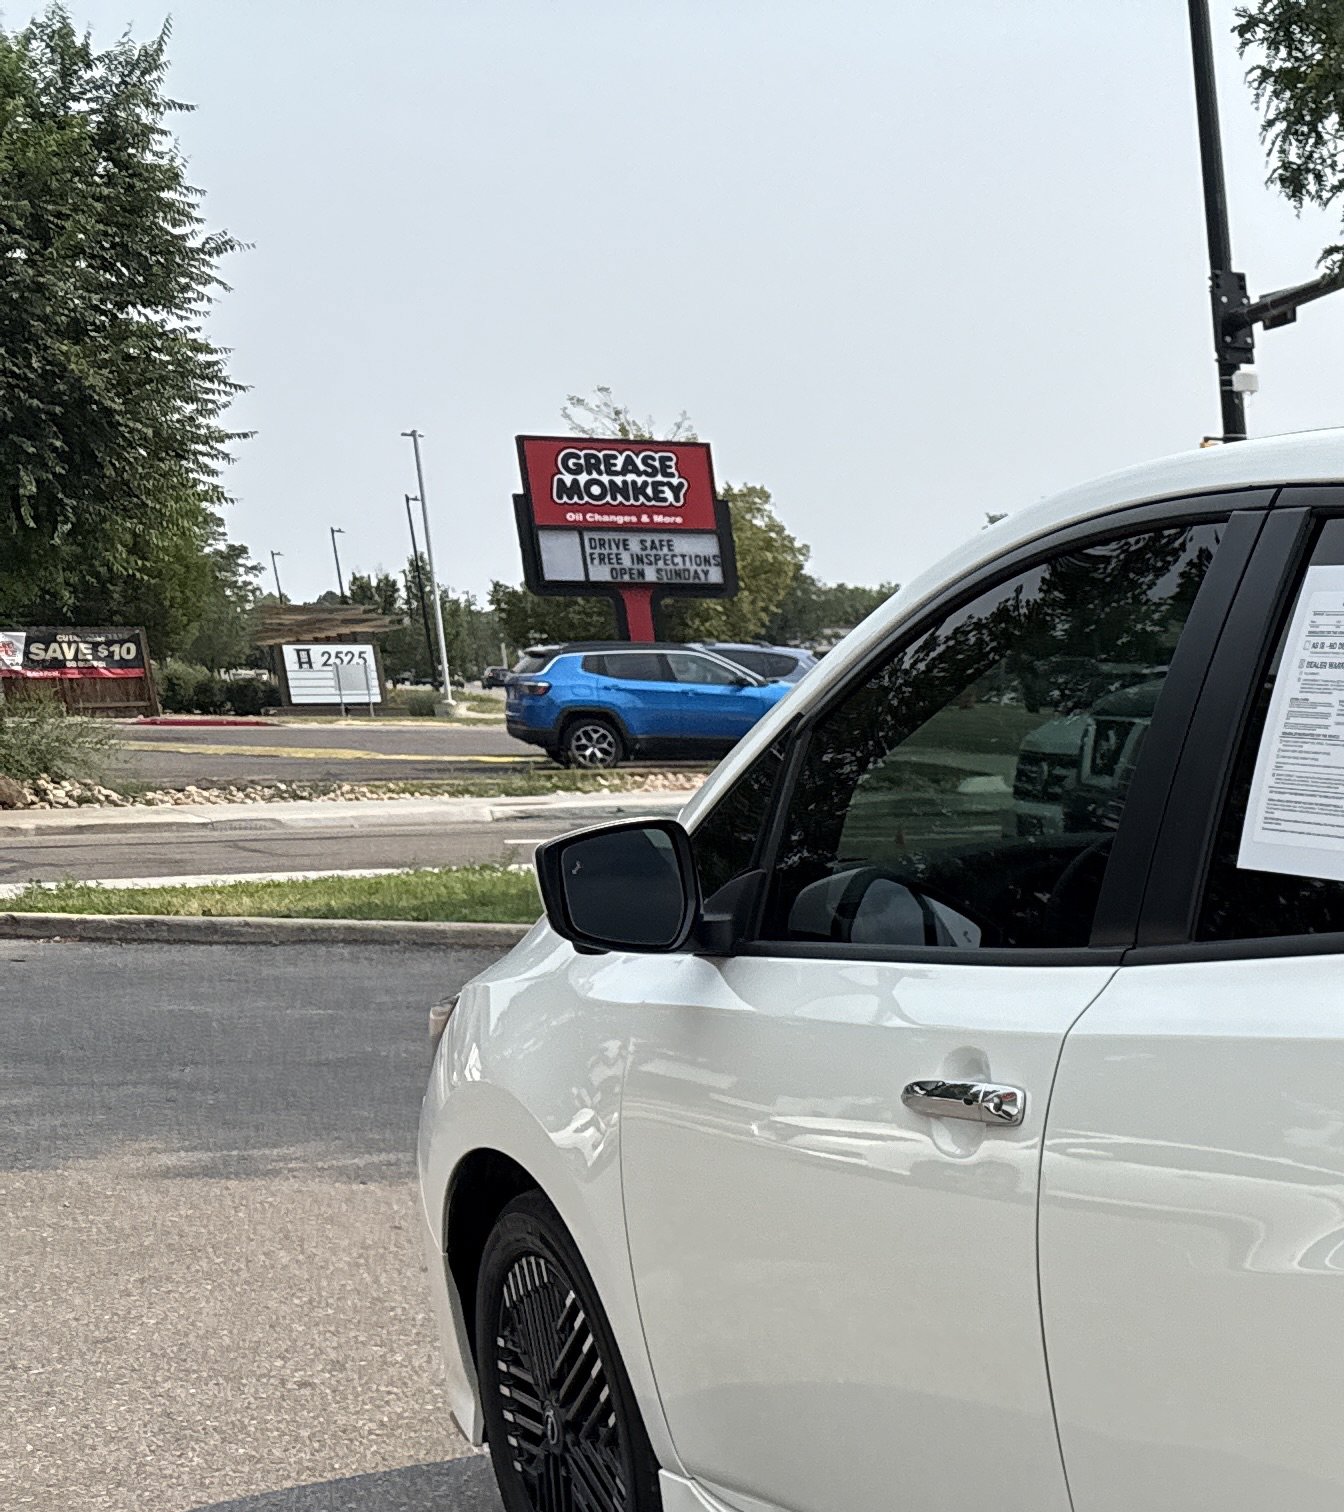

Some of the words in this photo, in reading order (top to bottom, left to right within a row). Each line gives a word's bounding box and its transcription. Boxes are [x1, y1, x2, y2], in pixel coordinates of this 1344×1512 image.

[559, 450, 677, 479] GREASE
[555, 477, 686, 504] MONKEY
[566, 512, 583, 522] Oil
[586, 513, 638, 524] Changes
[640, 514, 650, 523] &
[653, 514, 683, 524] More
[588, 537, 631, 551] DRIVE
[640, 539, 675, 552] SAFE
[589, 552, 624, 566] FREE
[631, 553, 721, 567] INSPECTIONS
[610, 567, 646, 580] OPEN
[656, 568, 710, 581] SUNDAY
[28, 642, 93, 661] SAVE
[97, 642, 137, 661] $10
[320, 650, 368, 667] 2525
